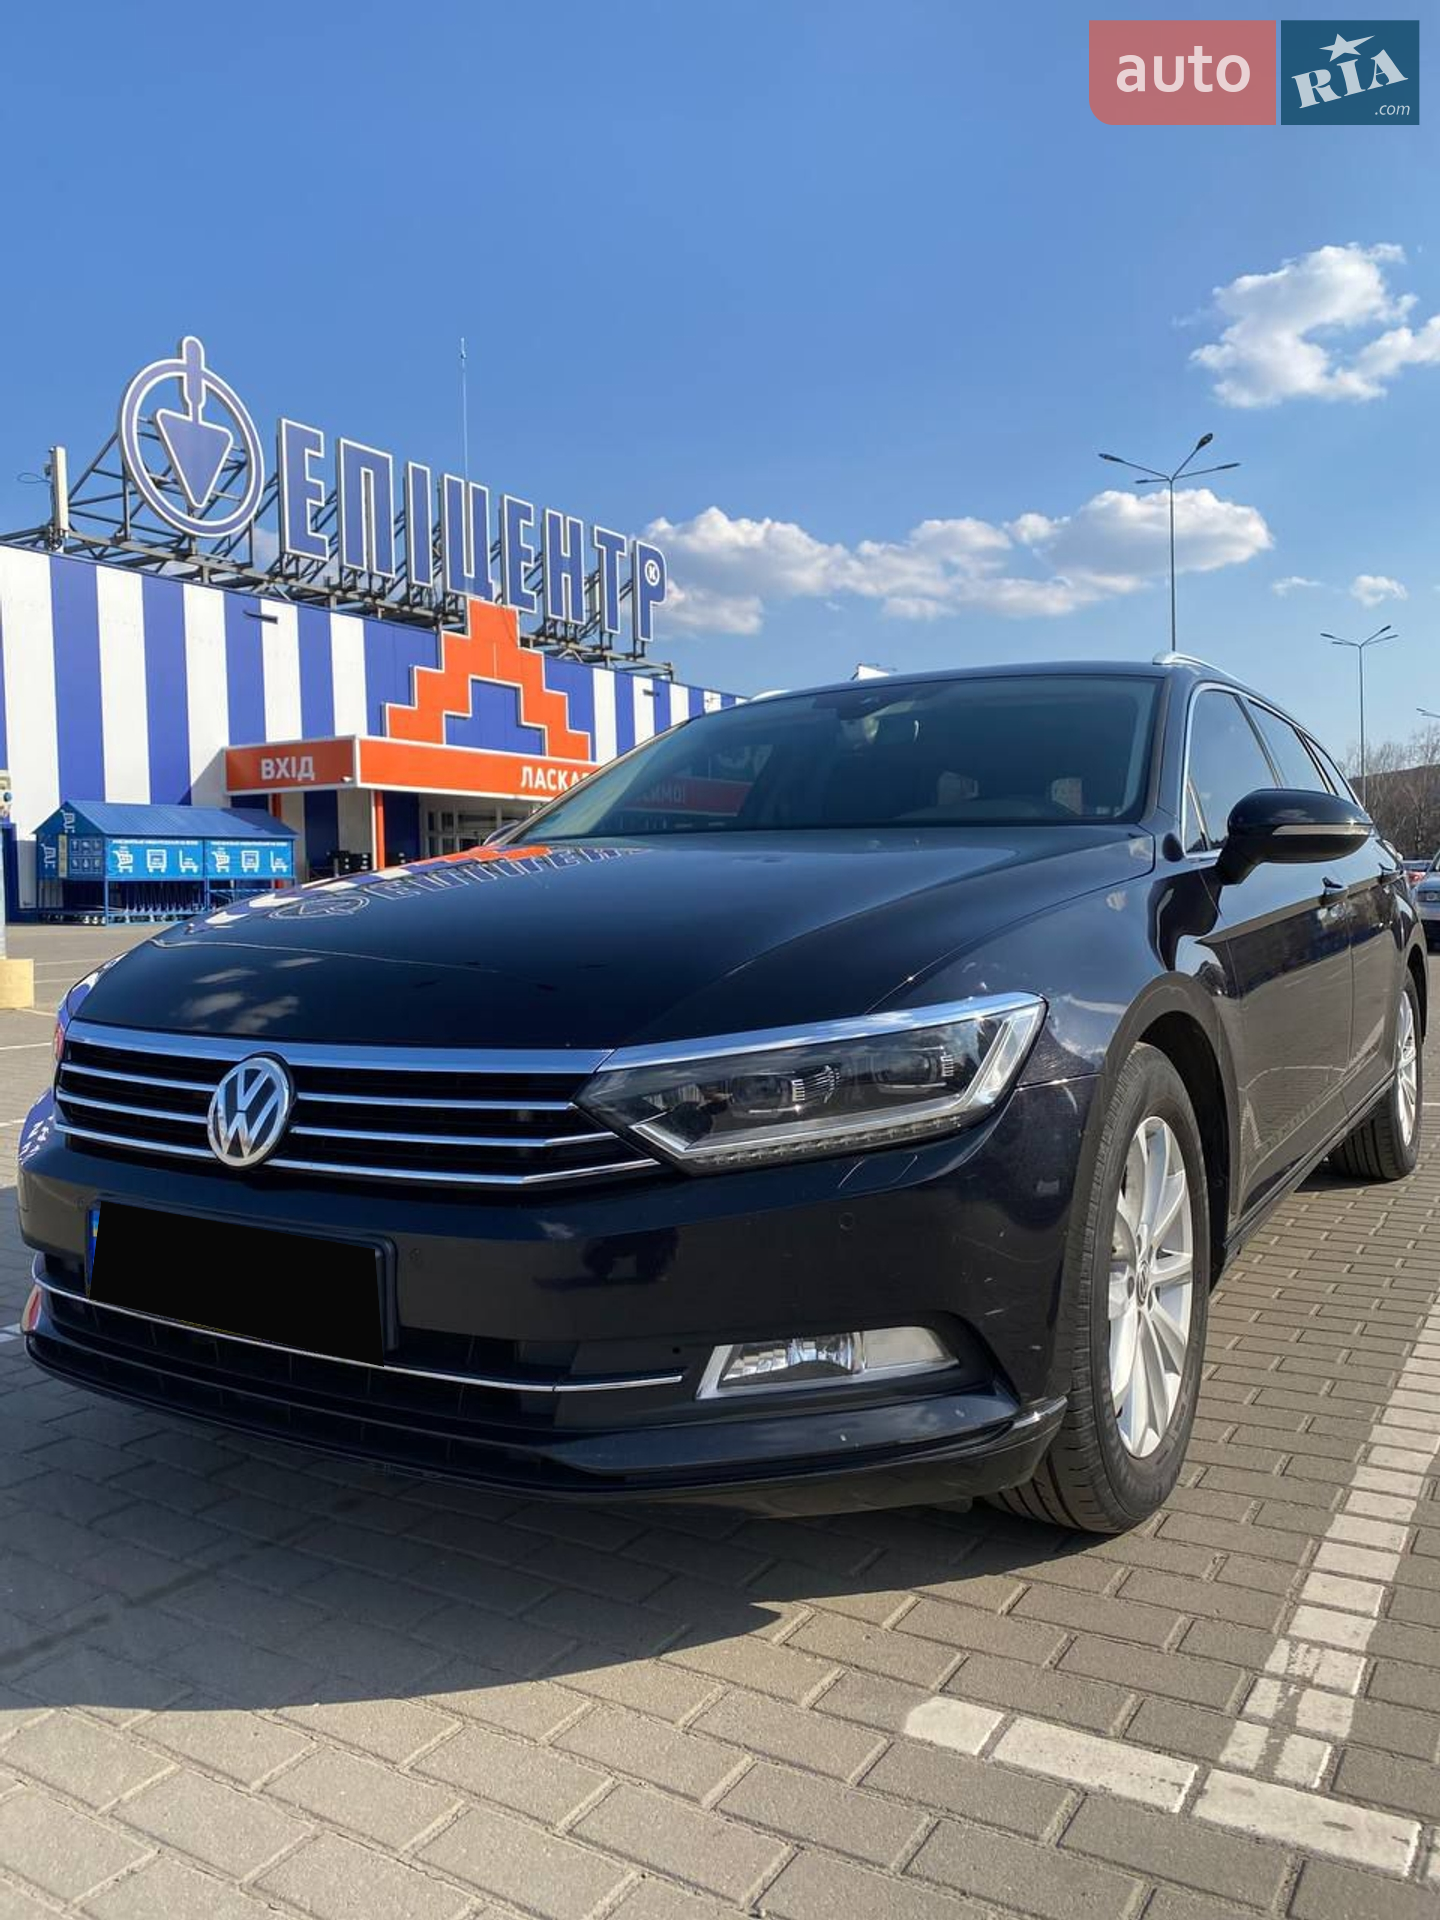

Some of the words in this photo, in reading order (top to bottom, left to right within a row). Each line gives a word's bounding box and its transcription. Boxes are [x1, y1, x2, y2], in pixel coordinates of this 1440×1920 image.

[278, 417, 668, 643] ЕПІЦЕНТР
[260, 755, 316, 782] ВХІД
[520, 765, 590, 792] ЛАСКА
[210, 1059, 287, 1164] VW
